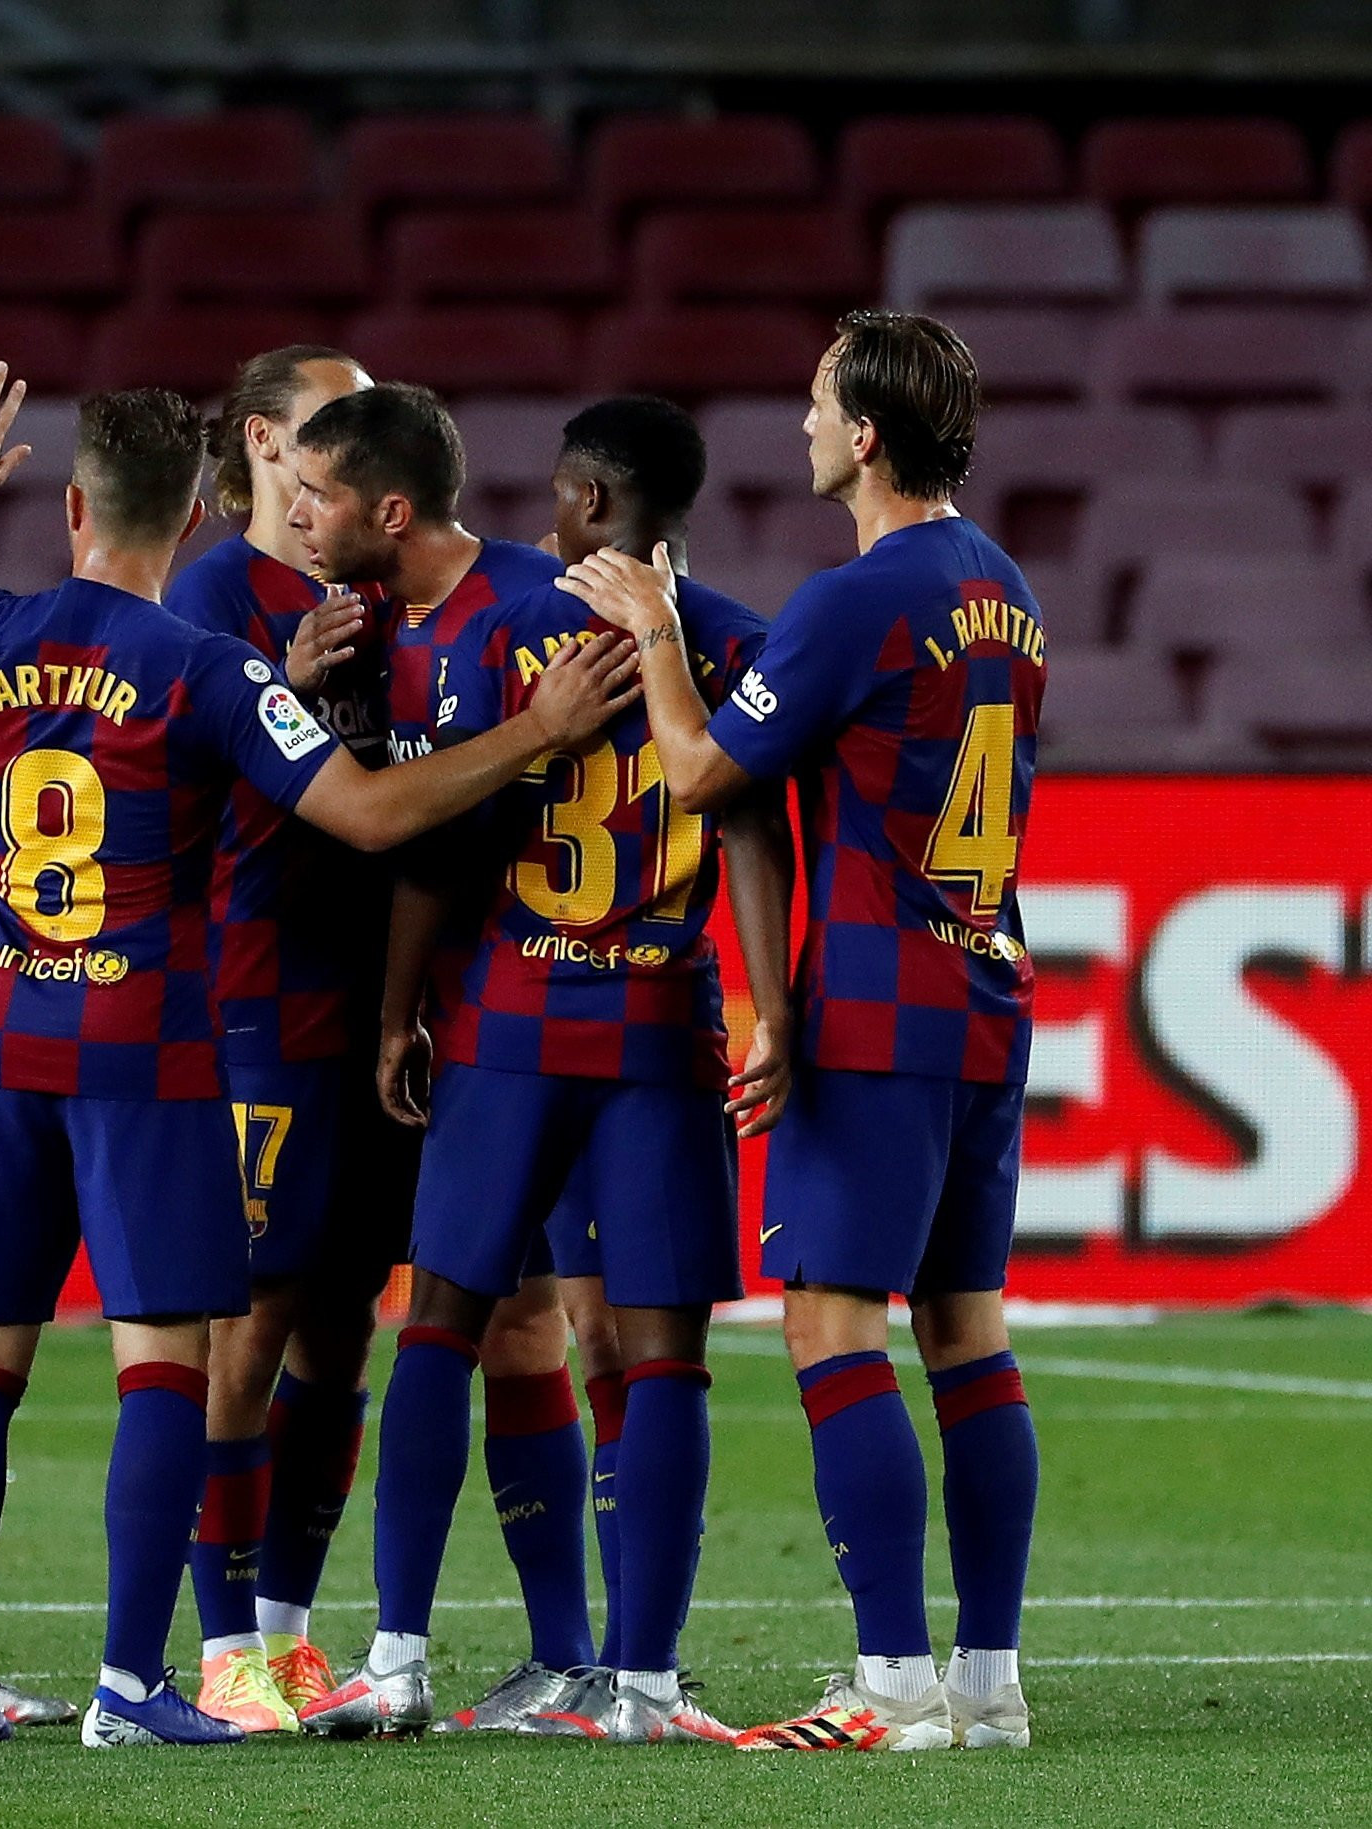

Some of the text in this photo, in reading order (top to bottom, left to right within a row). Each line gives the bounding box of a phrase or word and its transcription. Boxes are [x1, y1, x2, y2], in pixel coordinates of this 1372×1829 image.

[283, 728, 320, 751] LaLiga
[506, 739, 702, 926] 31
[921, 703, 1018, 916] 4
[0, 748, 106, 943] 8
[520, 930, 622, 970] unicef
[1014, 884, 1372, 1241] ES
